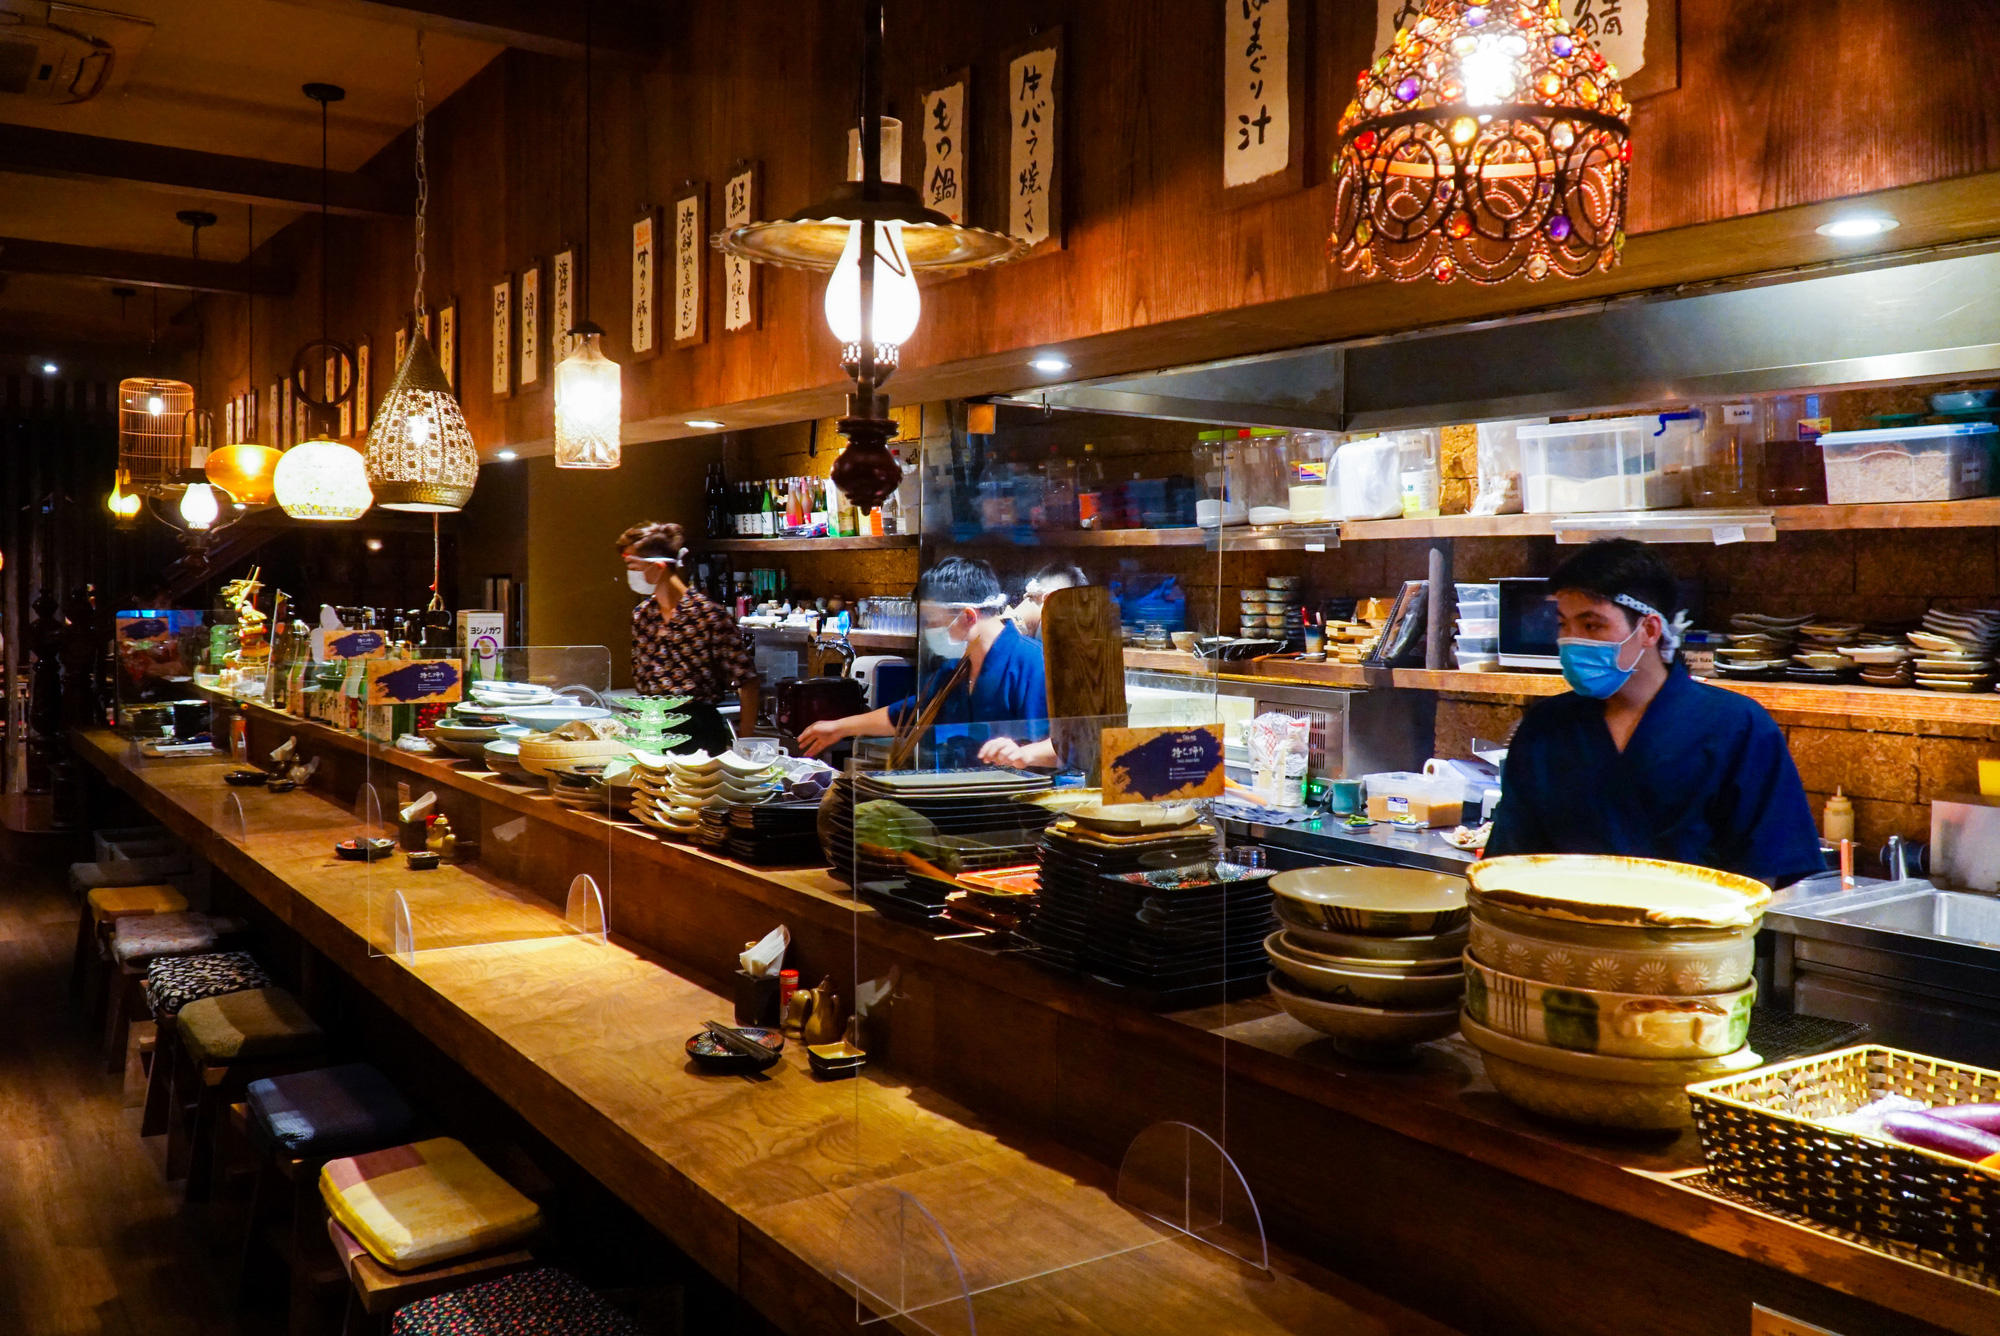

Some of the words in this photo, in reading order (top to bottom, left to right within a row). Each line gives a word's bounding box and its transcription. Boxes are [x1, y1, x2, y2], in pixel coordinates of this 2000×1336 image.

[931, 98, 957, 205] もつ鍋
[730, 181, 746, 320] 鮭ス焼き
[470, 626, 502, 635] ヨシノガワ
